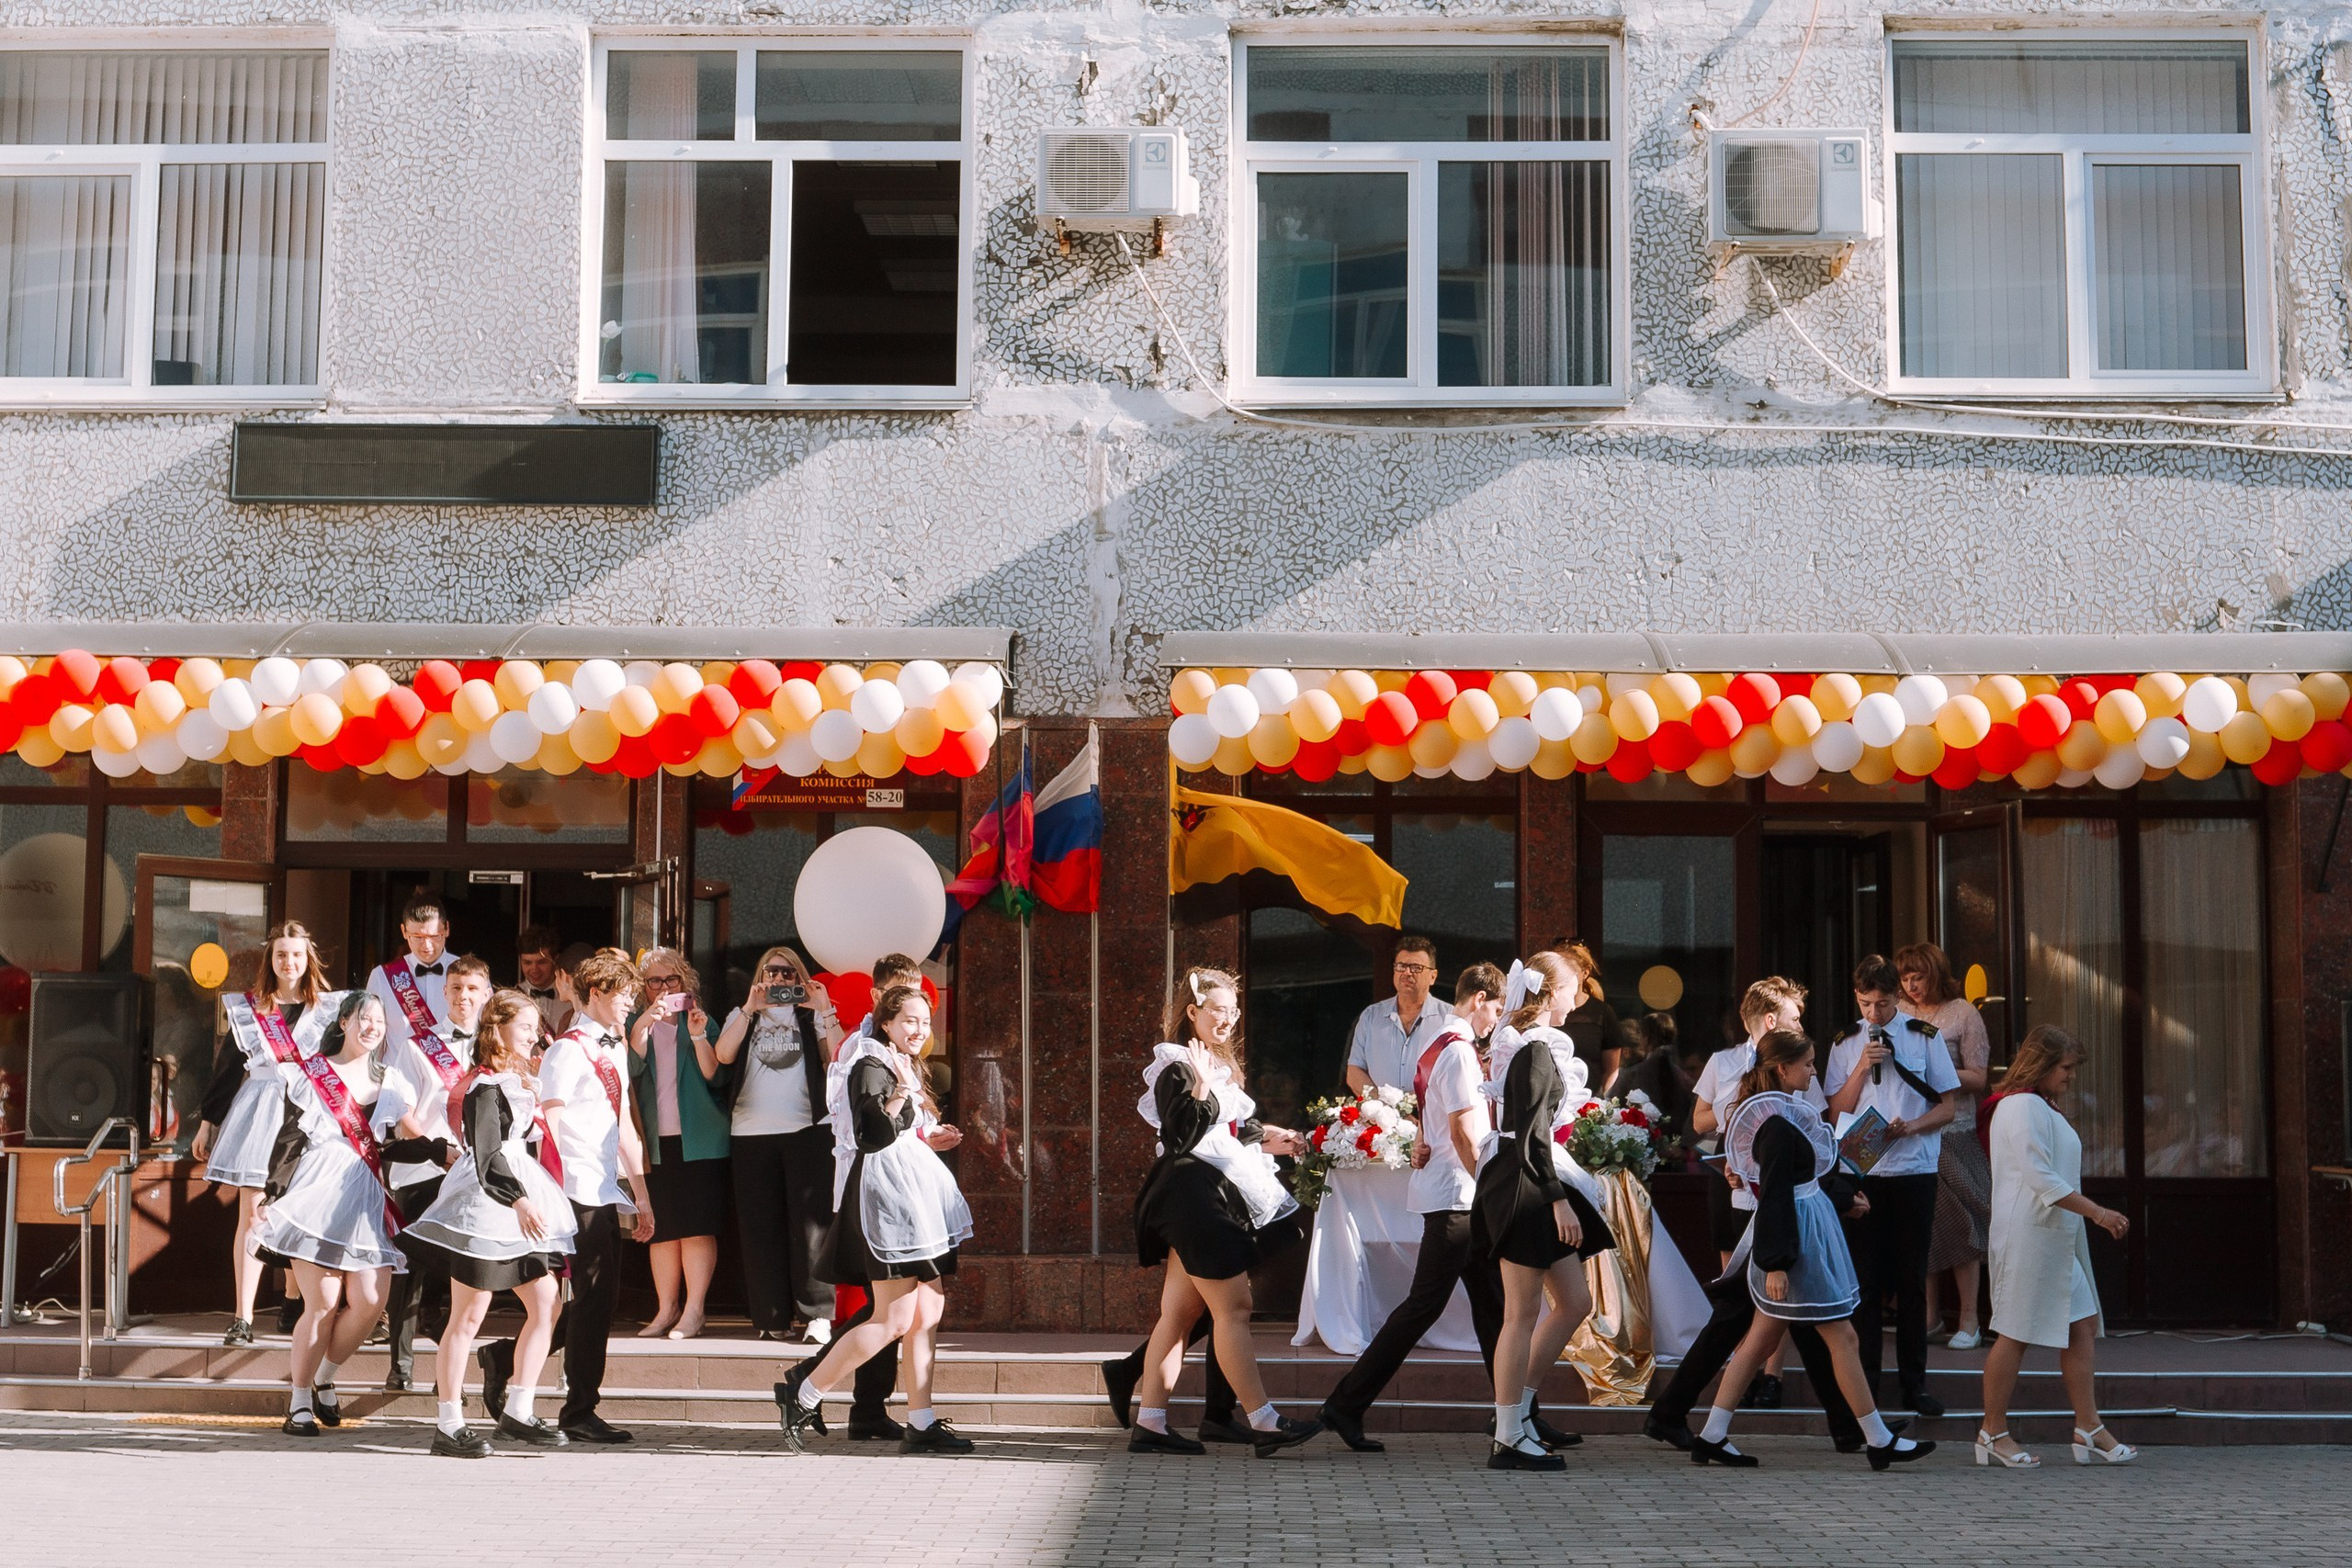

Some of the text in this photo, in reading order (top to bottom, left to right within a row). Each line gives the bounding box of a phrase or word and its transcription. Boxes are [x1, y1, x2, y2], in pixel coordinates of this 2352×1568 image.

[800, 778, 875, 788] КОМИССИЯ
[740, 795, 815, 804] ИЗБИРАТЕЛЬНОГО
[817, 795, 854, 804] УЧАСТКА
[867, 791, 903, 804] 58-20
[758, 1043, 800, 1052] THE MOON
